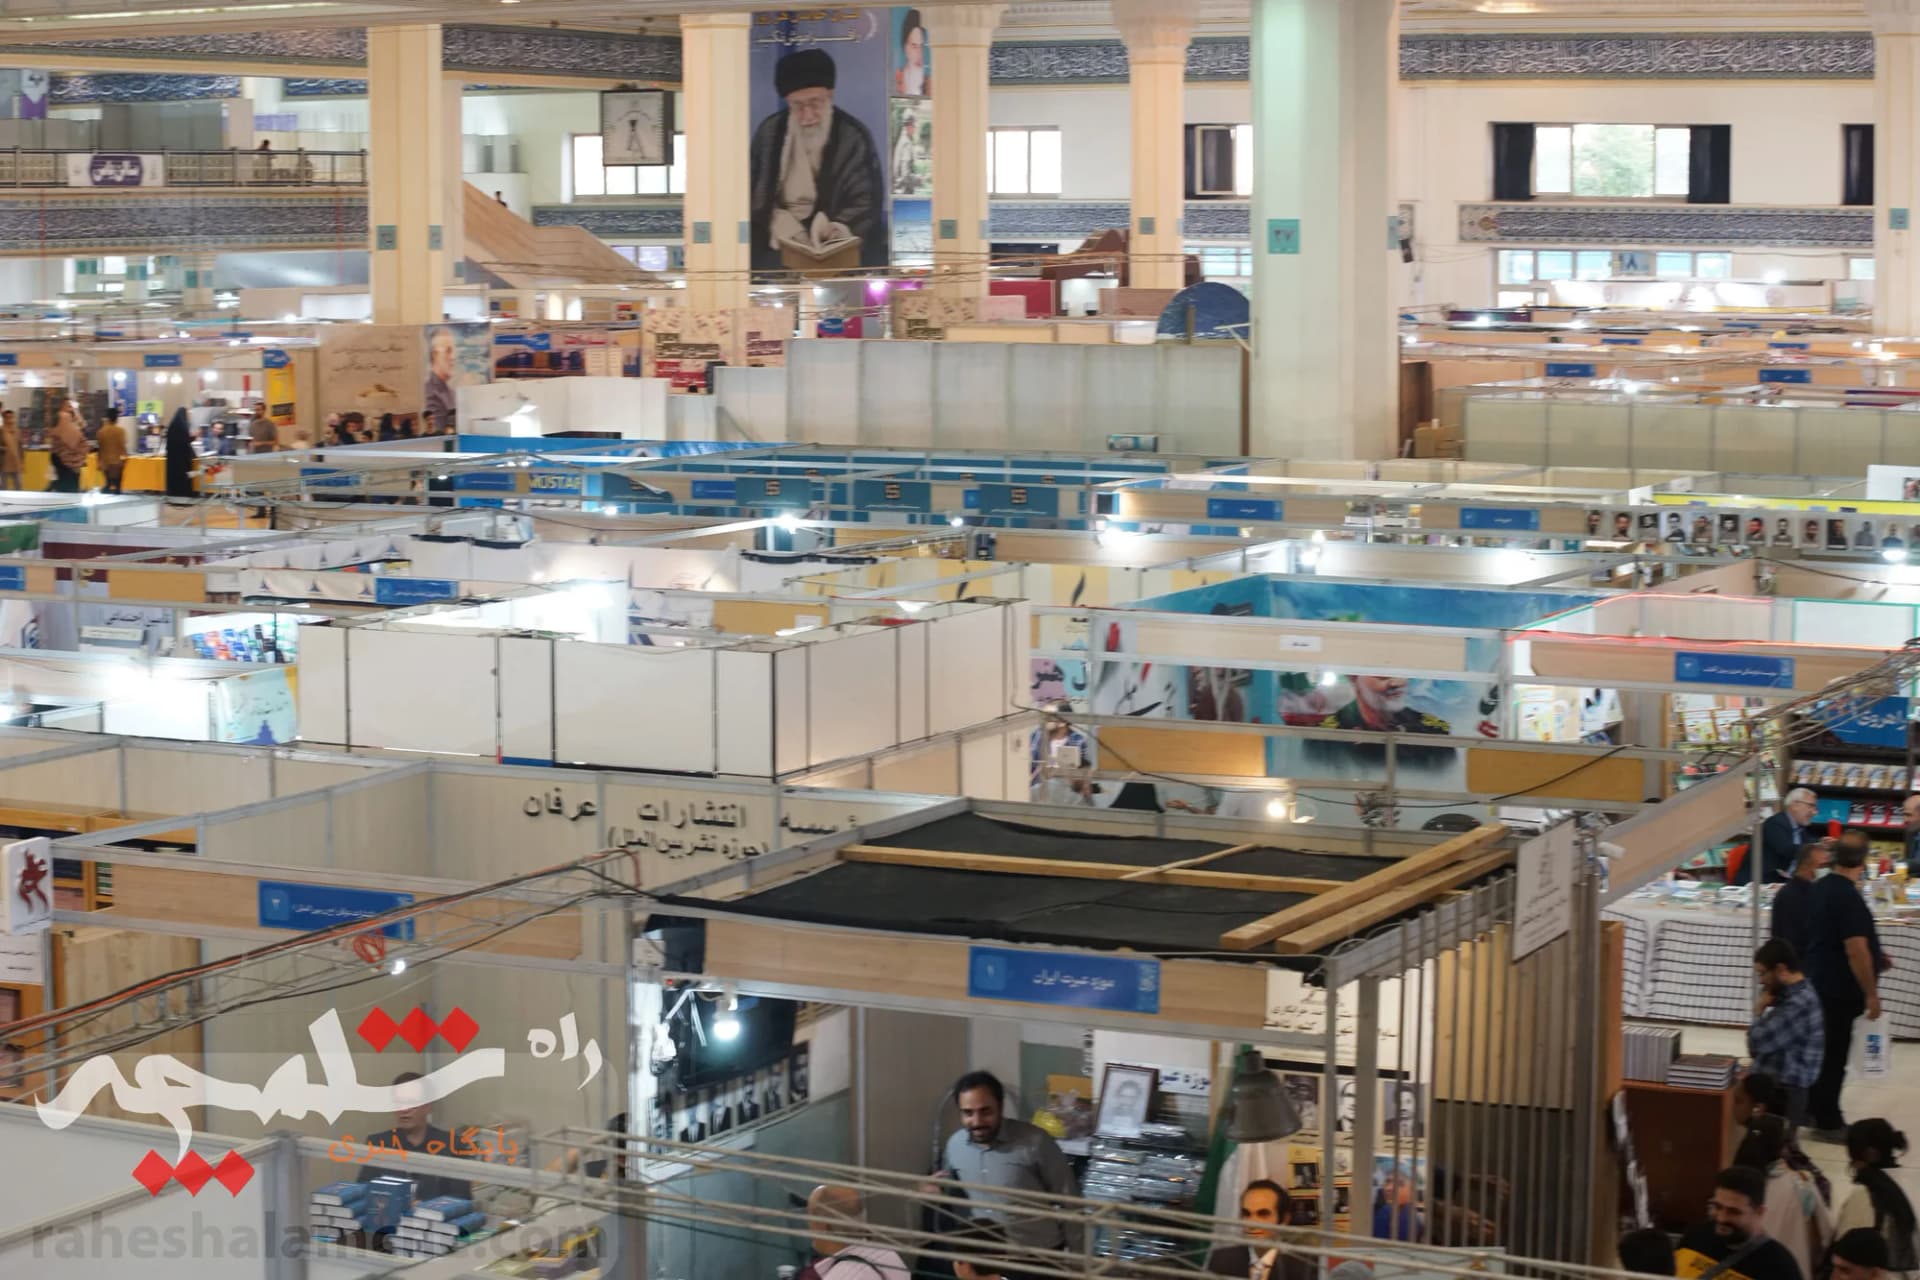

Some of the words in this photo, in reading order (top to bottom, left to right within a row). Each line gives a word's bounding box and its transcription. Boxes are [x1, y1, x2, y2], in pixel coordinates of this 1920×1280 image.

[523, 786, 598, 822] عرفان
[639, 800, 746, 829] انتشارات
[1032, 968, 1061, 985] ایران
